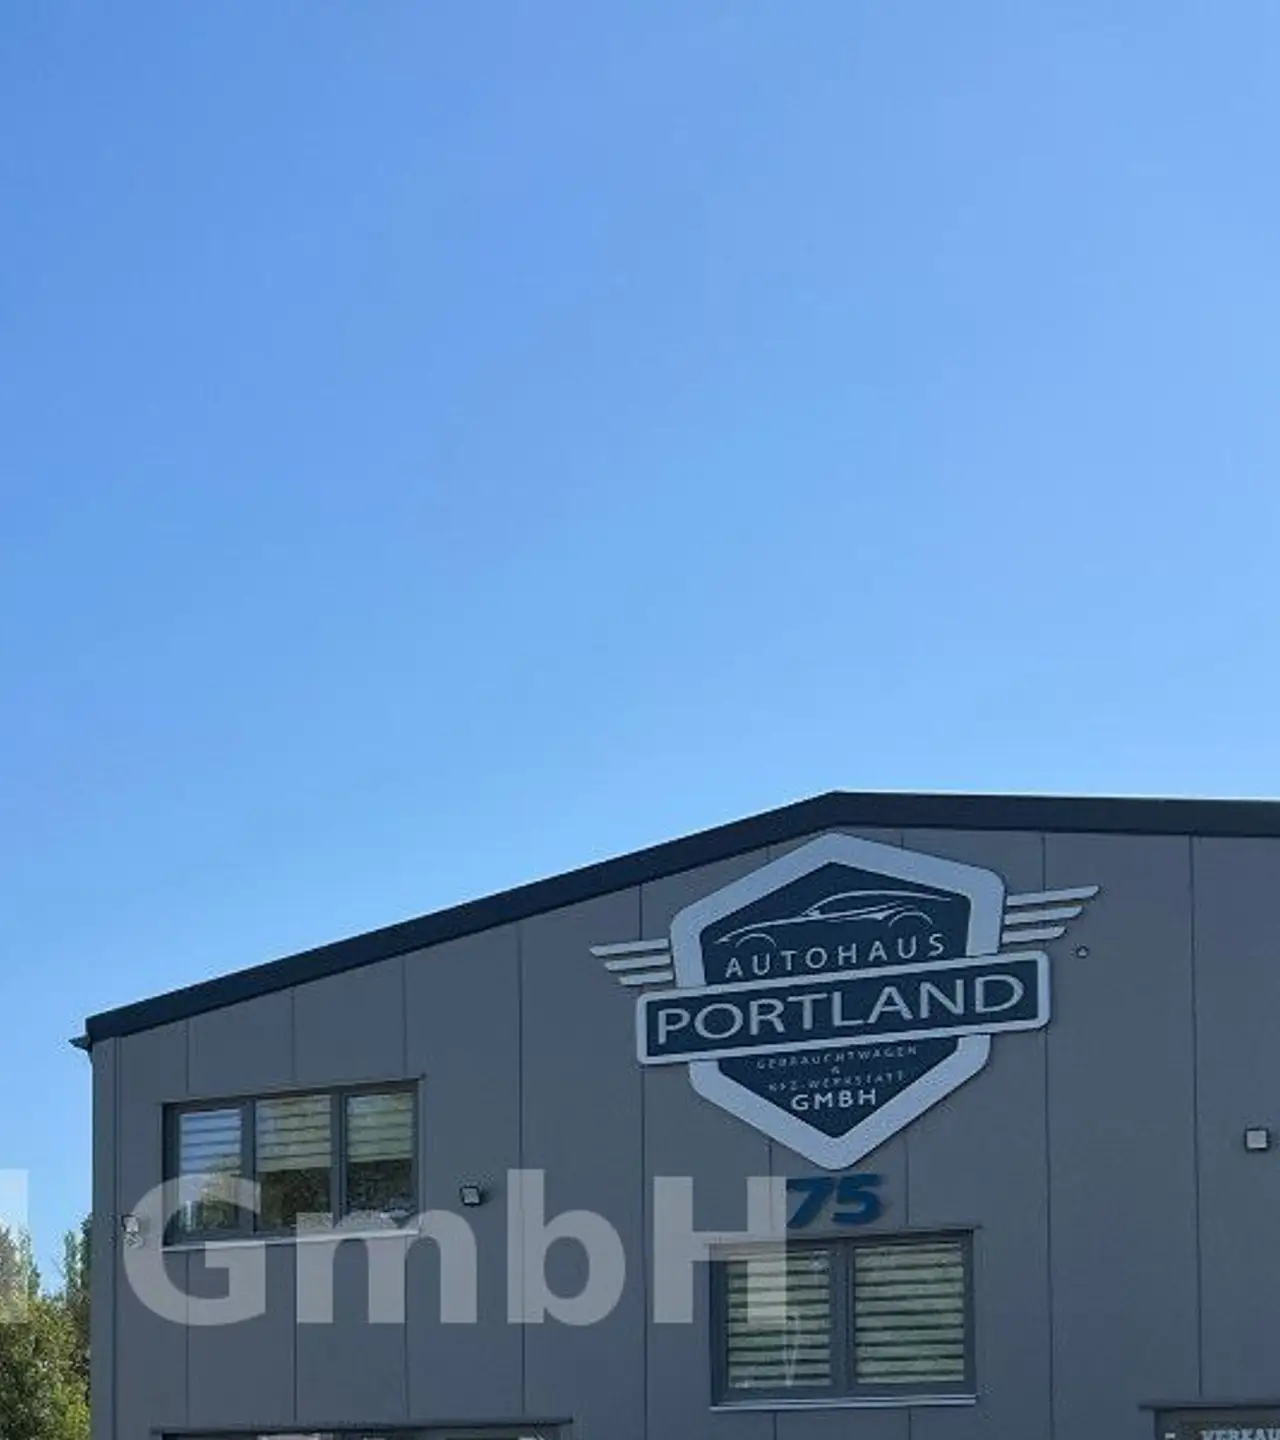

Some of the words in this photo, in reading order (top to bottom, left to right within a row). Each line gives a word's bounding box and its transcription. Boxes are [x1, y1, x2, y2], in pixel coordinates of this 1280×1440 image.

[725, 933, 946, 978] AUTOHAUS
[656, 973, 1025, 1046] PORTLAND
[756, 1043, 917, 1069] GEBRAUCHTWAGEN
[791, 1087, 877, 1111] GMBH
[787, 1172, 883, 1230] 75
